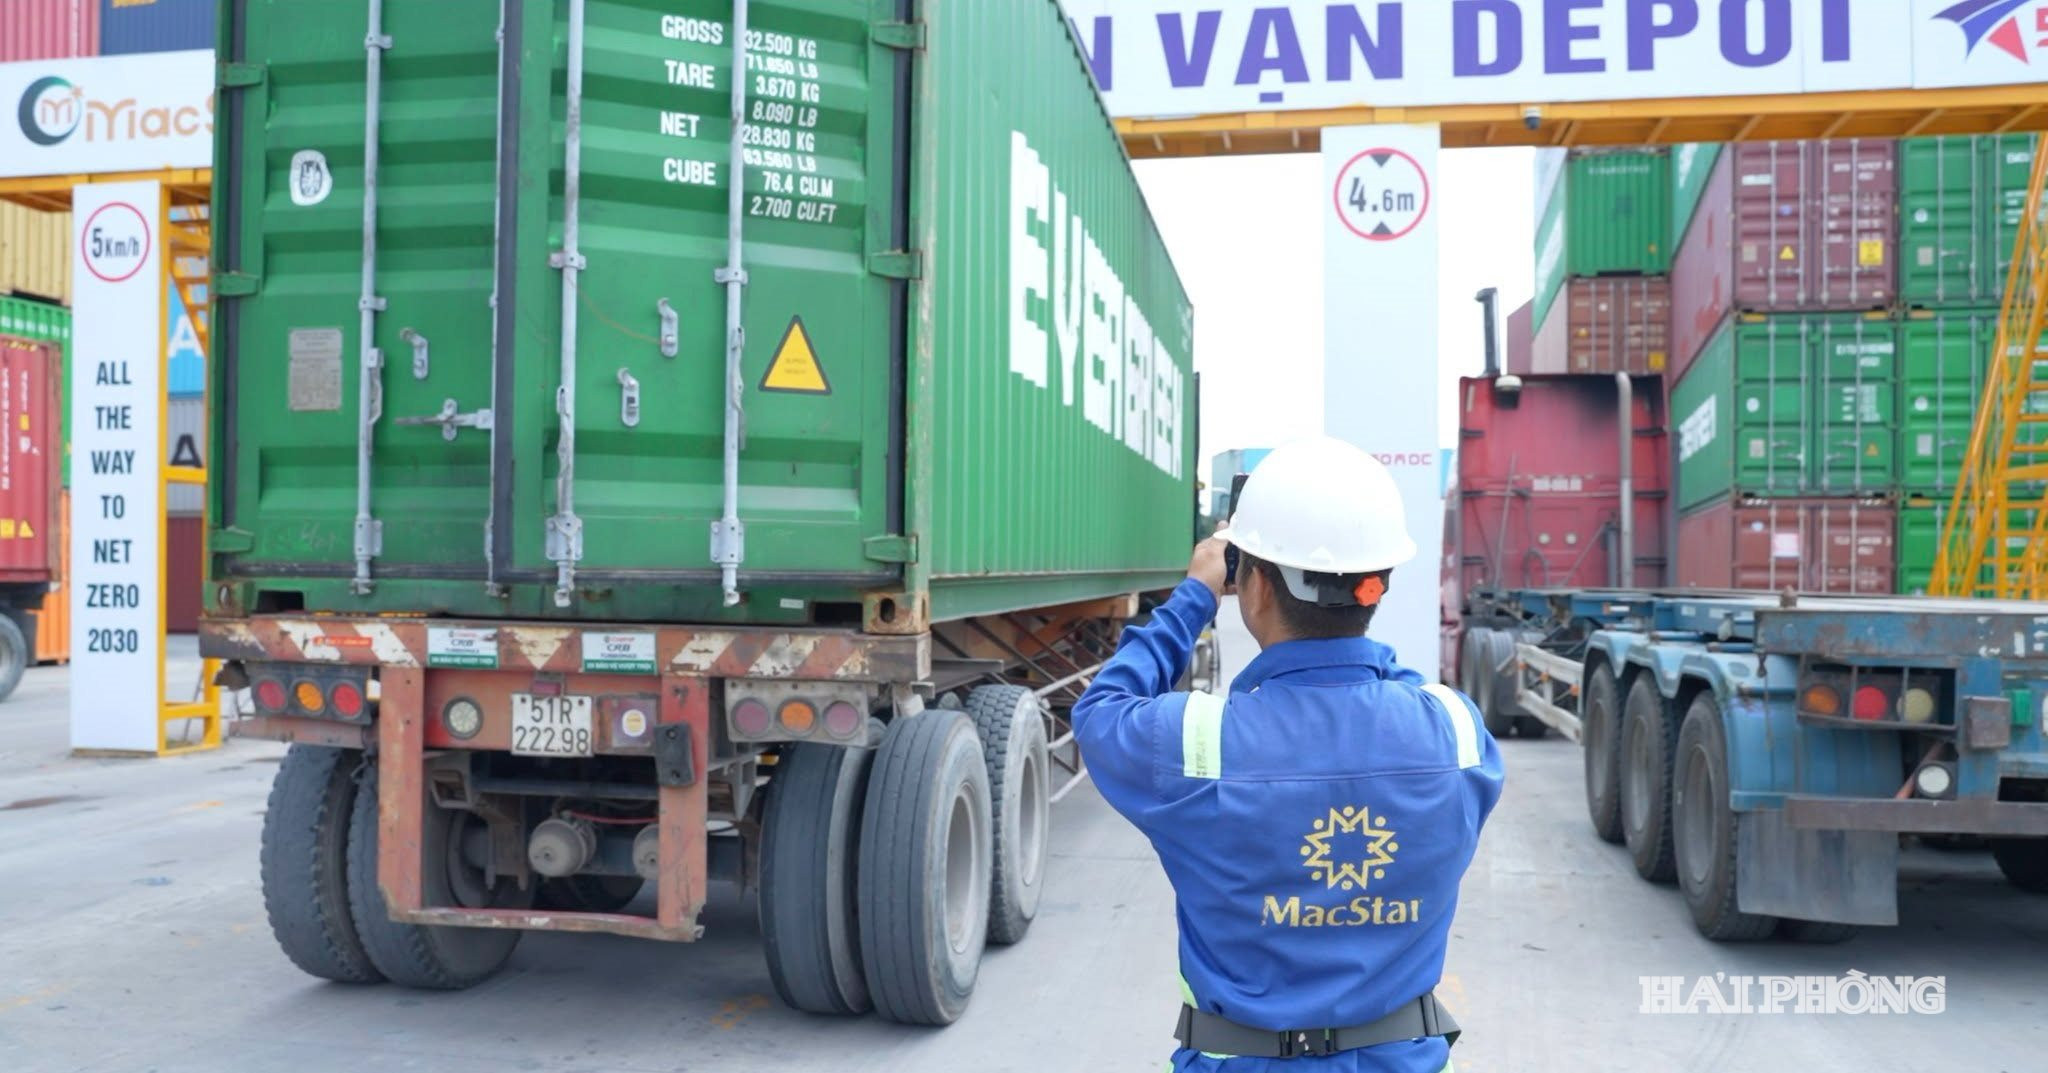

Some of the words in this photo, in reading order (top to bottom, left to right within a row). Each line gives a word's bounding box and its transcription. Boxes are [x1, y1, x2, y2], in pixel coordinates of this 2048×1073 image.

[661, 15, 723, 45] GROSS
[744, 30, 793, 56] 32.500
[798, 38, 816, 60] KG
[1155, 2, 1403, 103] VẠN
[1453, 0, 1851, 77] DEPOT
[664, 60, 715, 89] TARE
[799, 61, 818, 79] LB
[756, 75, 796, 99] 3.670
[801, 81, 819, 103] KG
[660, 111, 699, 138] NET
[752, 101, 793, 124] 8.090
[797, 106, 818, 127] LB
[742, 124, 791, 149] 28.830
[796, 131, 815, 152] KG
[663, 158, 716, 186] CUBE
[797, 155, 817, 173] LB
[762, 171, 793, 194] 76.4
[799, 176, 834, 198] CU.M
[1349, 177, 1414, 213] 4.6m
[750, 196, 792, 218] 2.700
[797, 201, 837, 223] CU.FT
[96, 361, 132, 385] ALL
[95, 405, 132, 430] THE
[91, 450, 135, 474] WAY
[101, 495, 125, 519] TO
[94, 539, 132, 563] NET
[86, 584, 139, 608] ZERO
[88, 628, 138, 653] 2030
[531, 697, 573, 724] 51R
[515, 726, 589, 754] 222.98
[1261, 895, 1423, 927] MacStar
